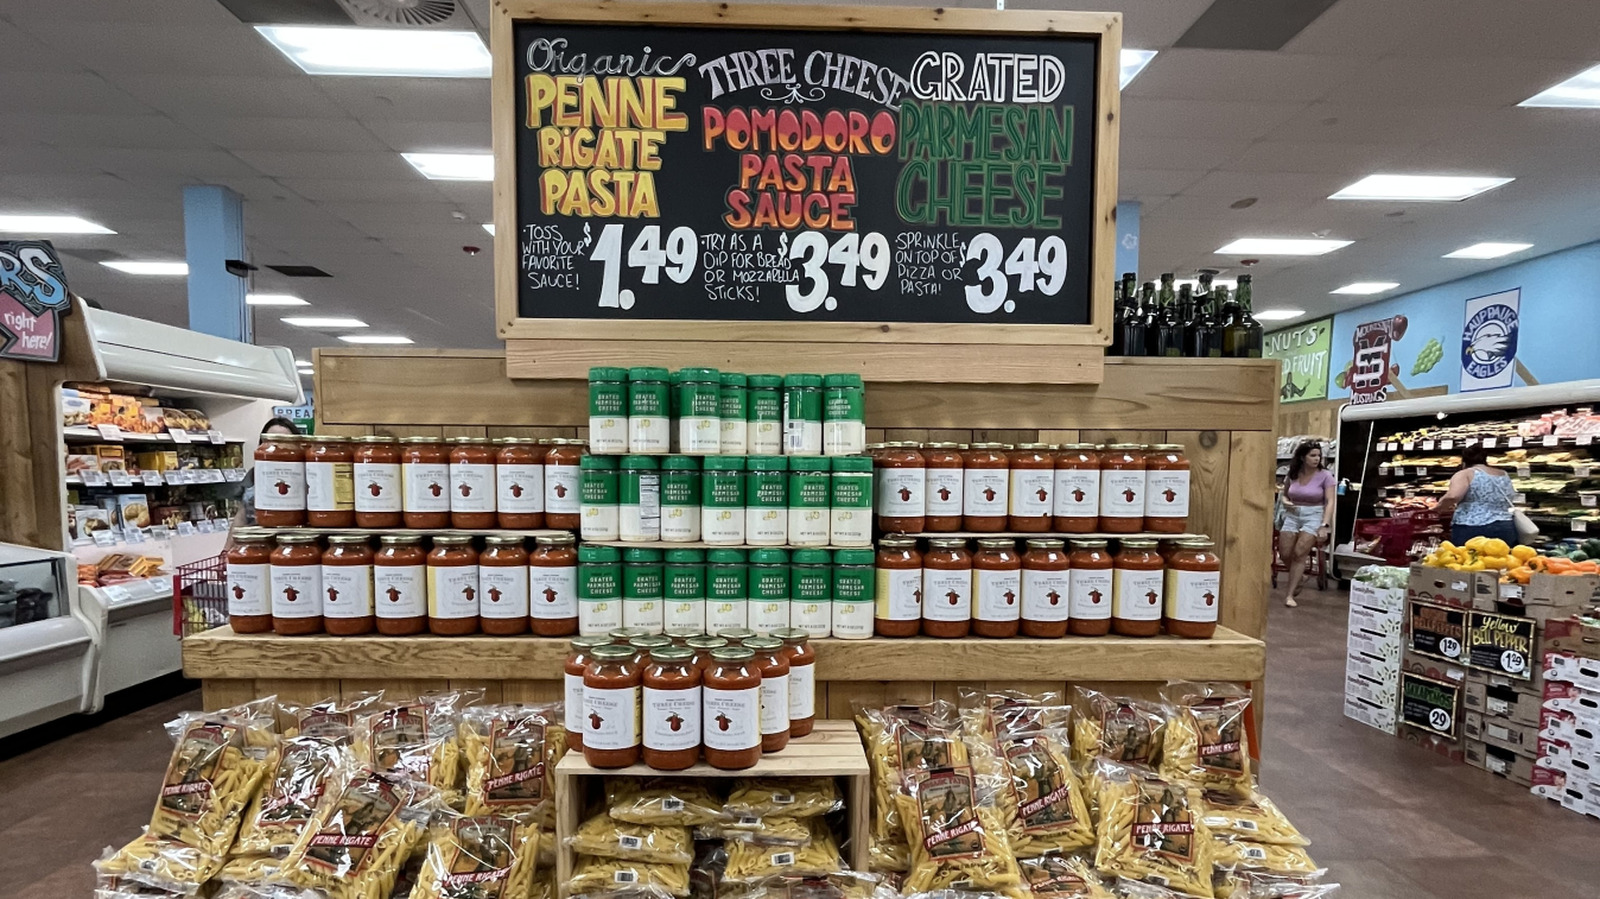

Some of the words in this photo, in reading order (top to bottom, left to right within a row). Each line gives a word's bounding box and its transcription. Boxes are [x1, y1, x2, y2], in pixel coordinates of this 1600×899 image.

[526, 37, 697, 83] Organic
[698, 48, 797, 100] THREE
[804, 50, 910, 112] CHEESE
[910, 50, 1066, 103] GRATED
[525, 73, 689, 130] PENNE
[703, 106, 896, 154] POMODORO
[898, 99, 1074, 164] PARMESAN
[741, 153, 855, 192] PASTA
[539, 168, 660, 218] PASTA
[896, 158, 1065, 228] CHEESE
[724, 189, 857, 230] SAUCE
[526, 224, 563, 241] TOSS
[704, 233, 726, 250] TRY
[730, 234, 747, 251] AS
[752, 234, 763, 250] A
[552, 240, 585, 256] YOUR
[895, 251, 913, 264] ON
[915, 250, 938, 264] TOP
[940, 251, 958, 264] OF
[731, 253, 754, 268] FOR
[757, 253, 792, 269] BREAD
[528, 272, 579, 290] SAUCE!
[704, 269, 725, 283] OR
[941, 268, 963, 281] OR
[900, 279, 942, 297] PASTA!
[4, 312, 37, 331] right
[1463, 307, 1518, 341] HAUPPAUGE
[22, 331, 52, 350] here!
[1269, 326, 1318, 356] NUTS
[1292, 350, 1327, 380] FRUIT
[1467, 357, 1507, 378] EAGLES
[1350, 386, 1387, 405] MUSTANGS
[1494, 630, 1528, 653] PEPPER
[488, 775, 513, 789] PENNE
[515, 766, 543, 782] RIGATE
[164, 785, 182, 796] PENNE
[1022, 798, 1045, 816] PENNE
[1044, 788, 1068, 806] RIGATE
[926, 831, 951, 848] PENNE
[950, 821, 978, 838] RIGAT
[1162, 823, 1190, 833] RIGATE
[312, 834, 338, 846] PENNE
[340, 835, 373, 846] RIGATE
